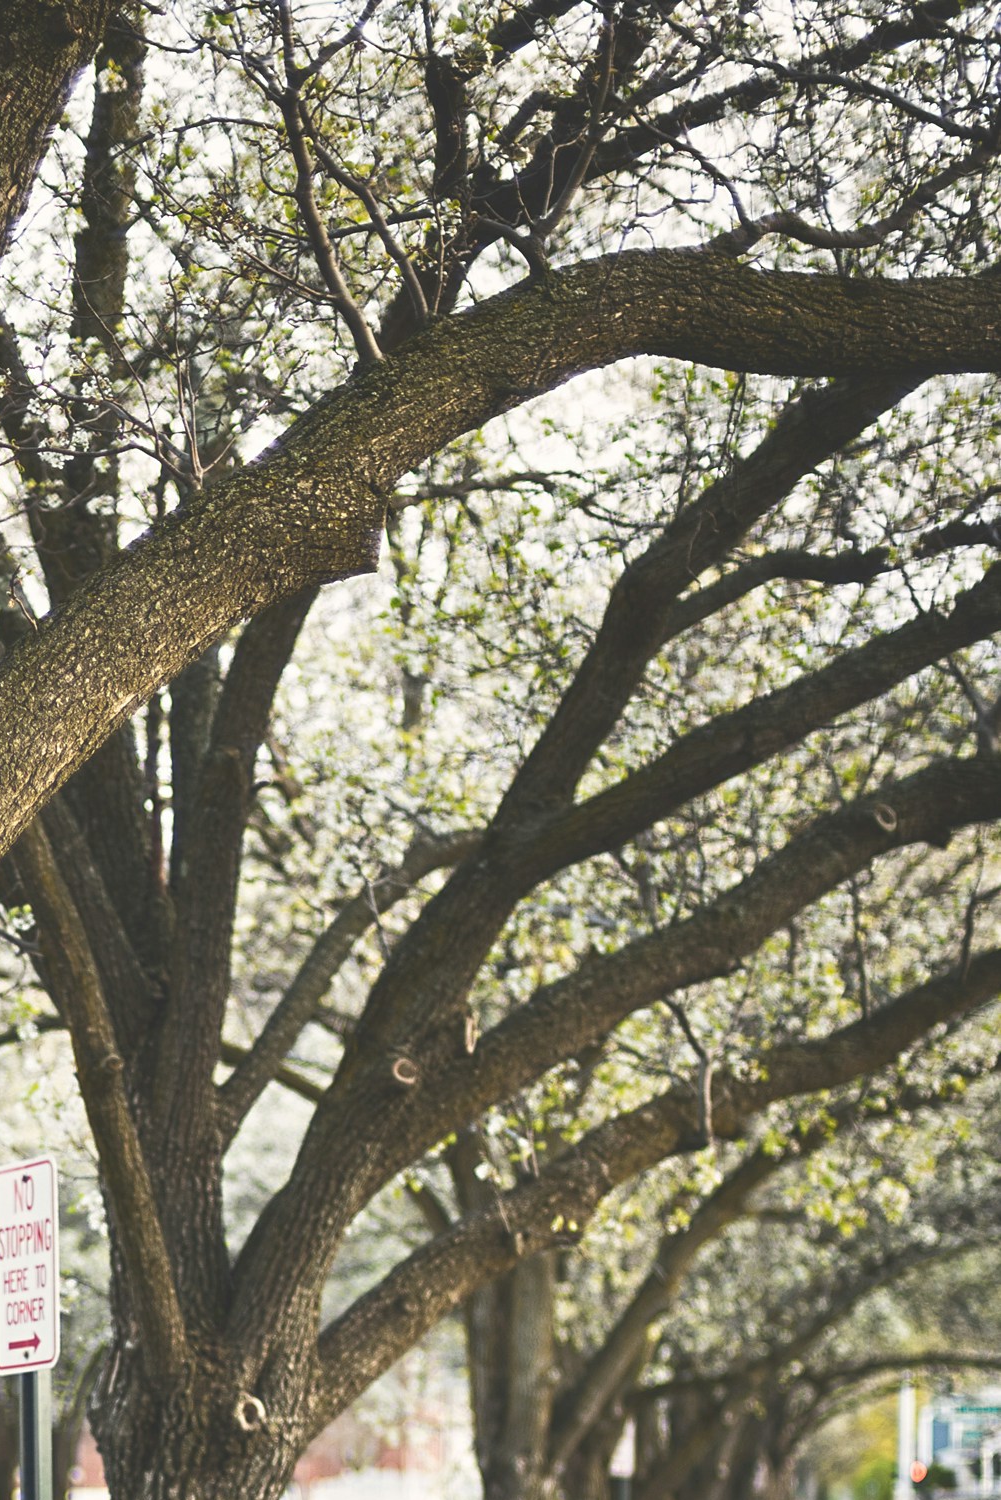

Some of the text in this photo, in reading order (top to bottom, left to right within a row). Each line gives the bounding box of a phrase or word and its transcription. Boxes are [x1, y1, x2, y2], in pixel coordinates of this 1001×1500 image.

[14, 1175, 35, 1213] NO
[0, 1218, 52, 1260] STOPPING
[3, 1264, 47, 1294] HERE TO
[6, 1297, 45, 1326] CORNER
